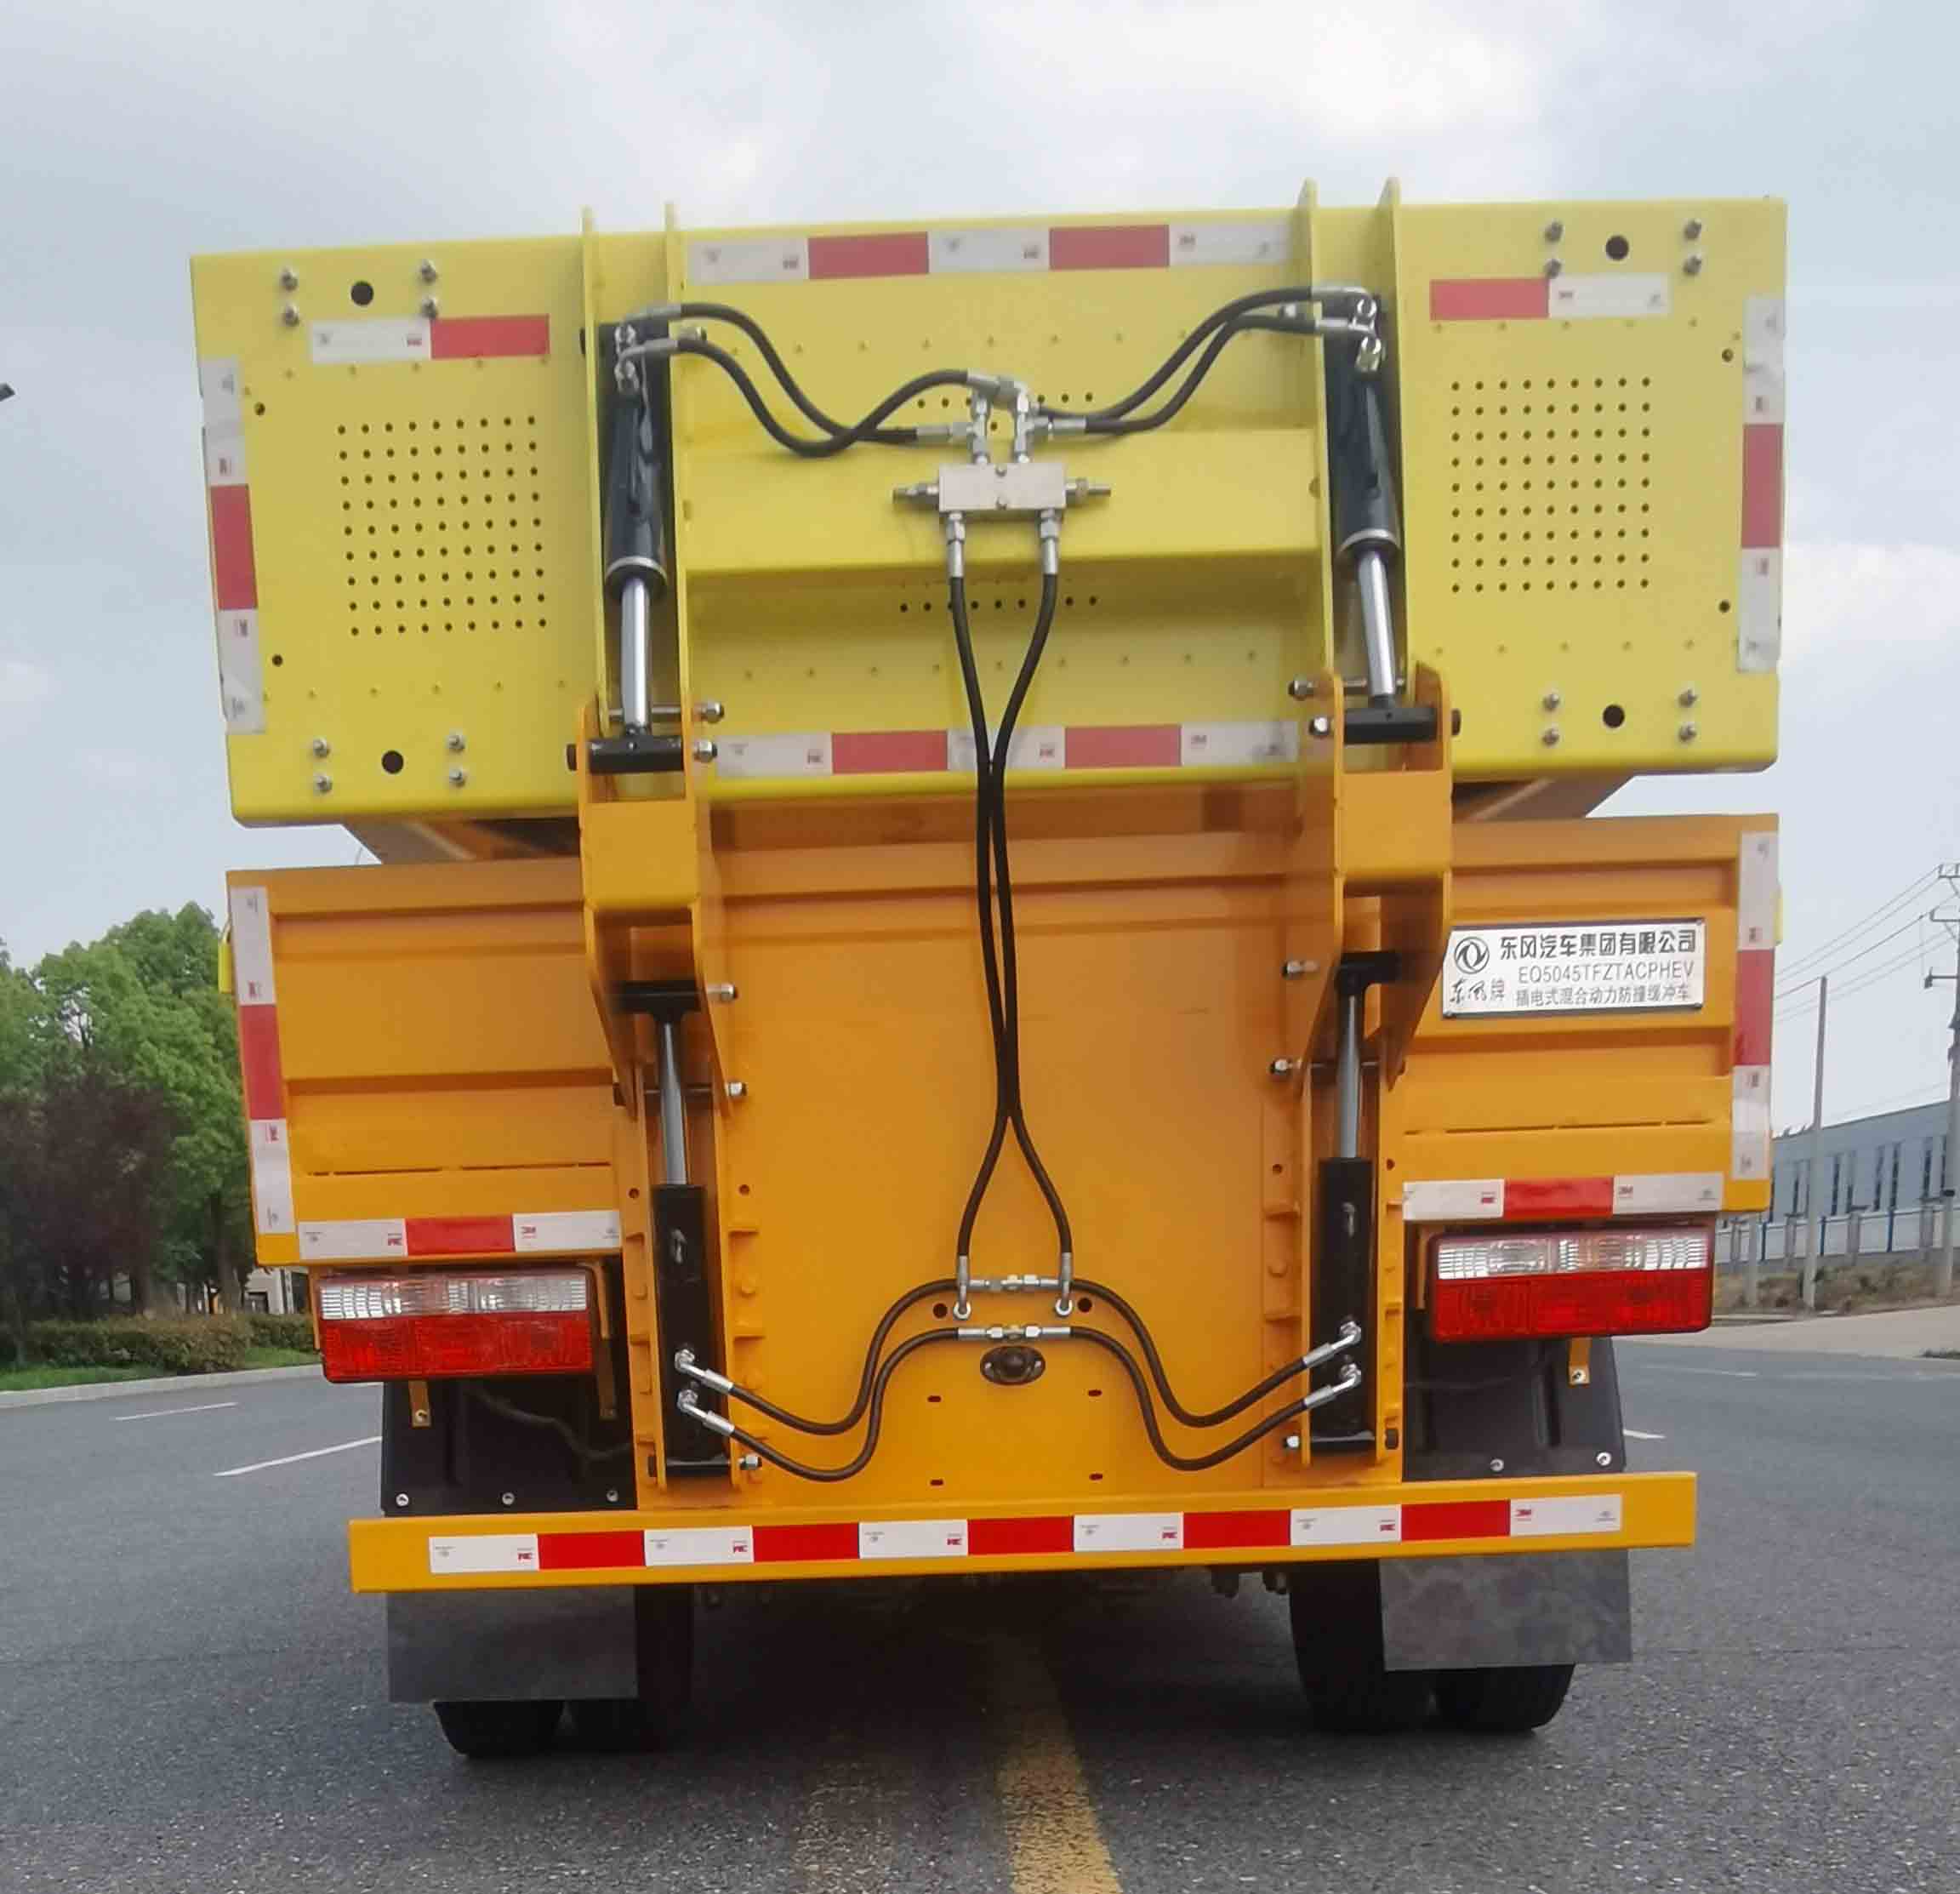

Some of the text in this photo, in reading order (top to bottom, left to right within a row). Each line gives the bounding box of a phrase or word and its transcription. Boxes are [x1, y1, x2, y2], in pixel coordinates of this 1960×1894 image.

[1500, 929, 1697, 960] 东风汽车集团有限公司
[1518, 961, 1695, 984] EQ5045TFZTACPHEV
